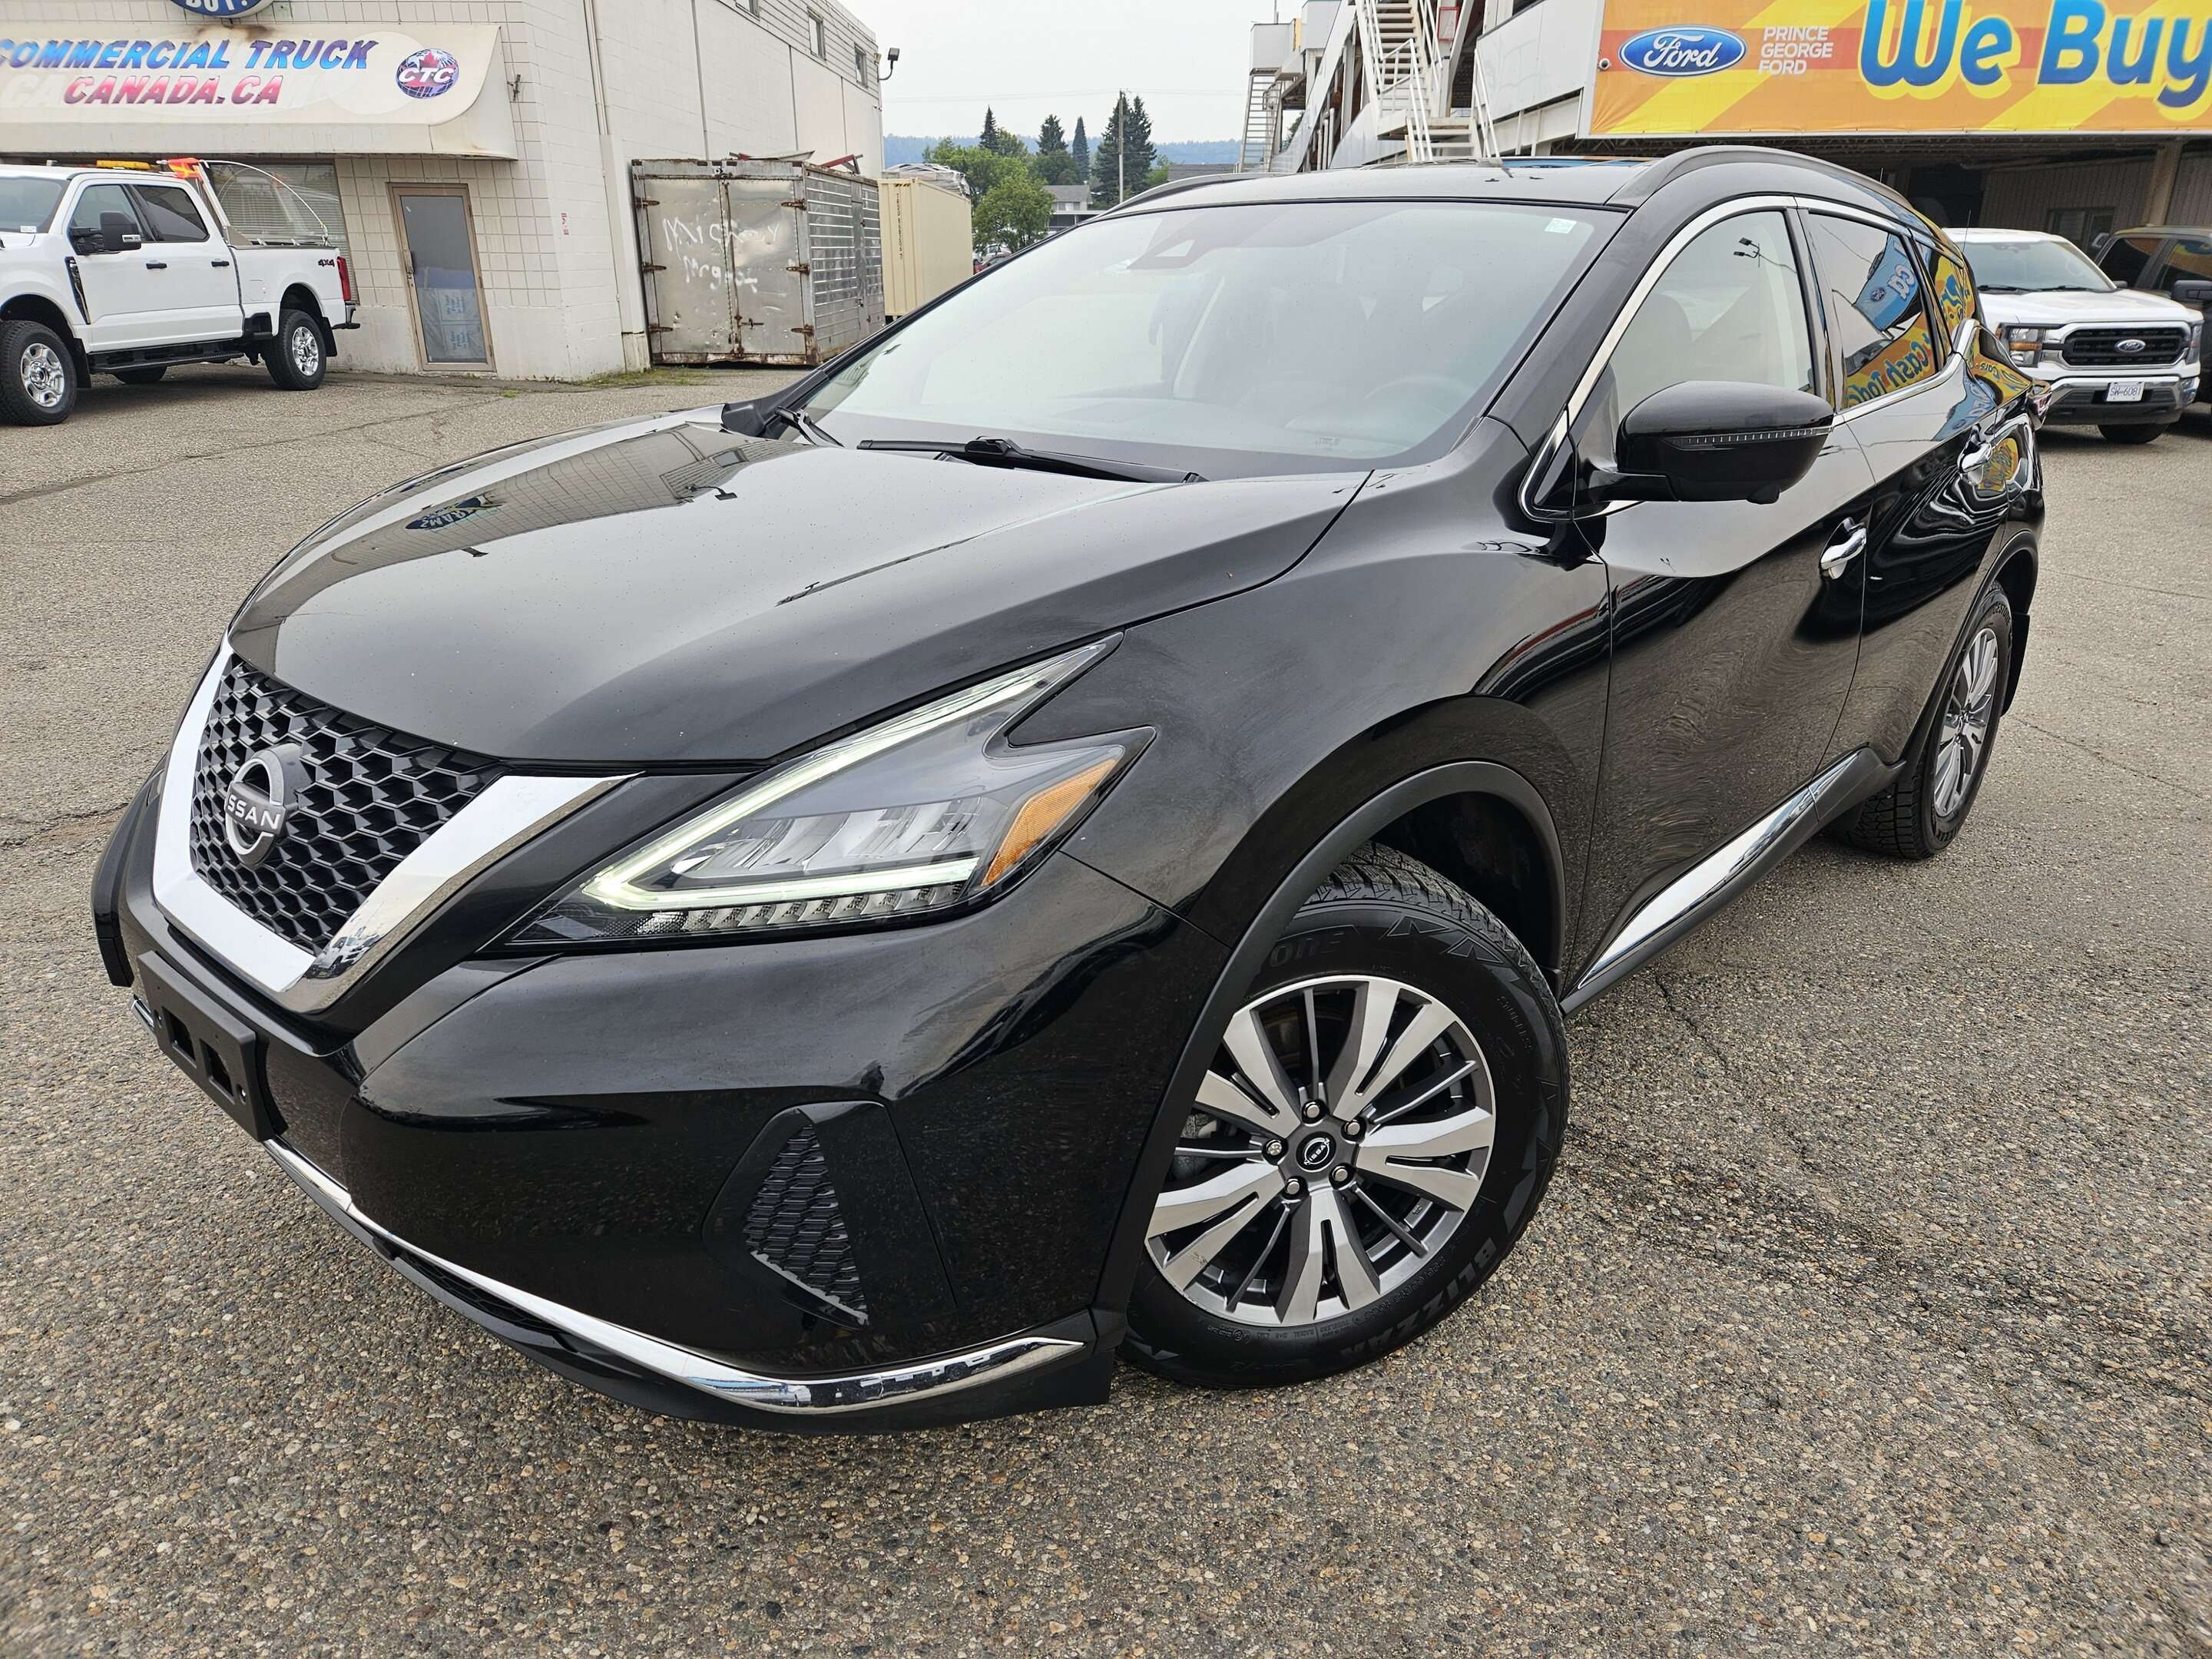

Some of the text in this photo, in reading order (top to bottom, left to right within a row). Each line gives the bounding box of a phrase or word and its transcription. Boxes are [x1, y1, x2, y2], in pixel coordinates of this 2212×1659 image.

[1763, 25, 1829, 41] PRINCE
[0, 39, 379, 69] COMMERCIAL TRUCK
[1643, 33, 1723, 68] Ford
[1761, 42, 1834, 58] GEORGE
[1860, 0, 2212, 108] We Buy
[398, 67, 455, 84] CTC
[1758, 59, 1807, 75] FORD
[63, 75, 283, 104] CANADA.CA
[227, 794, 281, 830] SSAN
